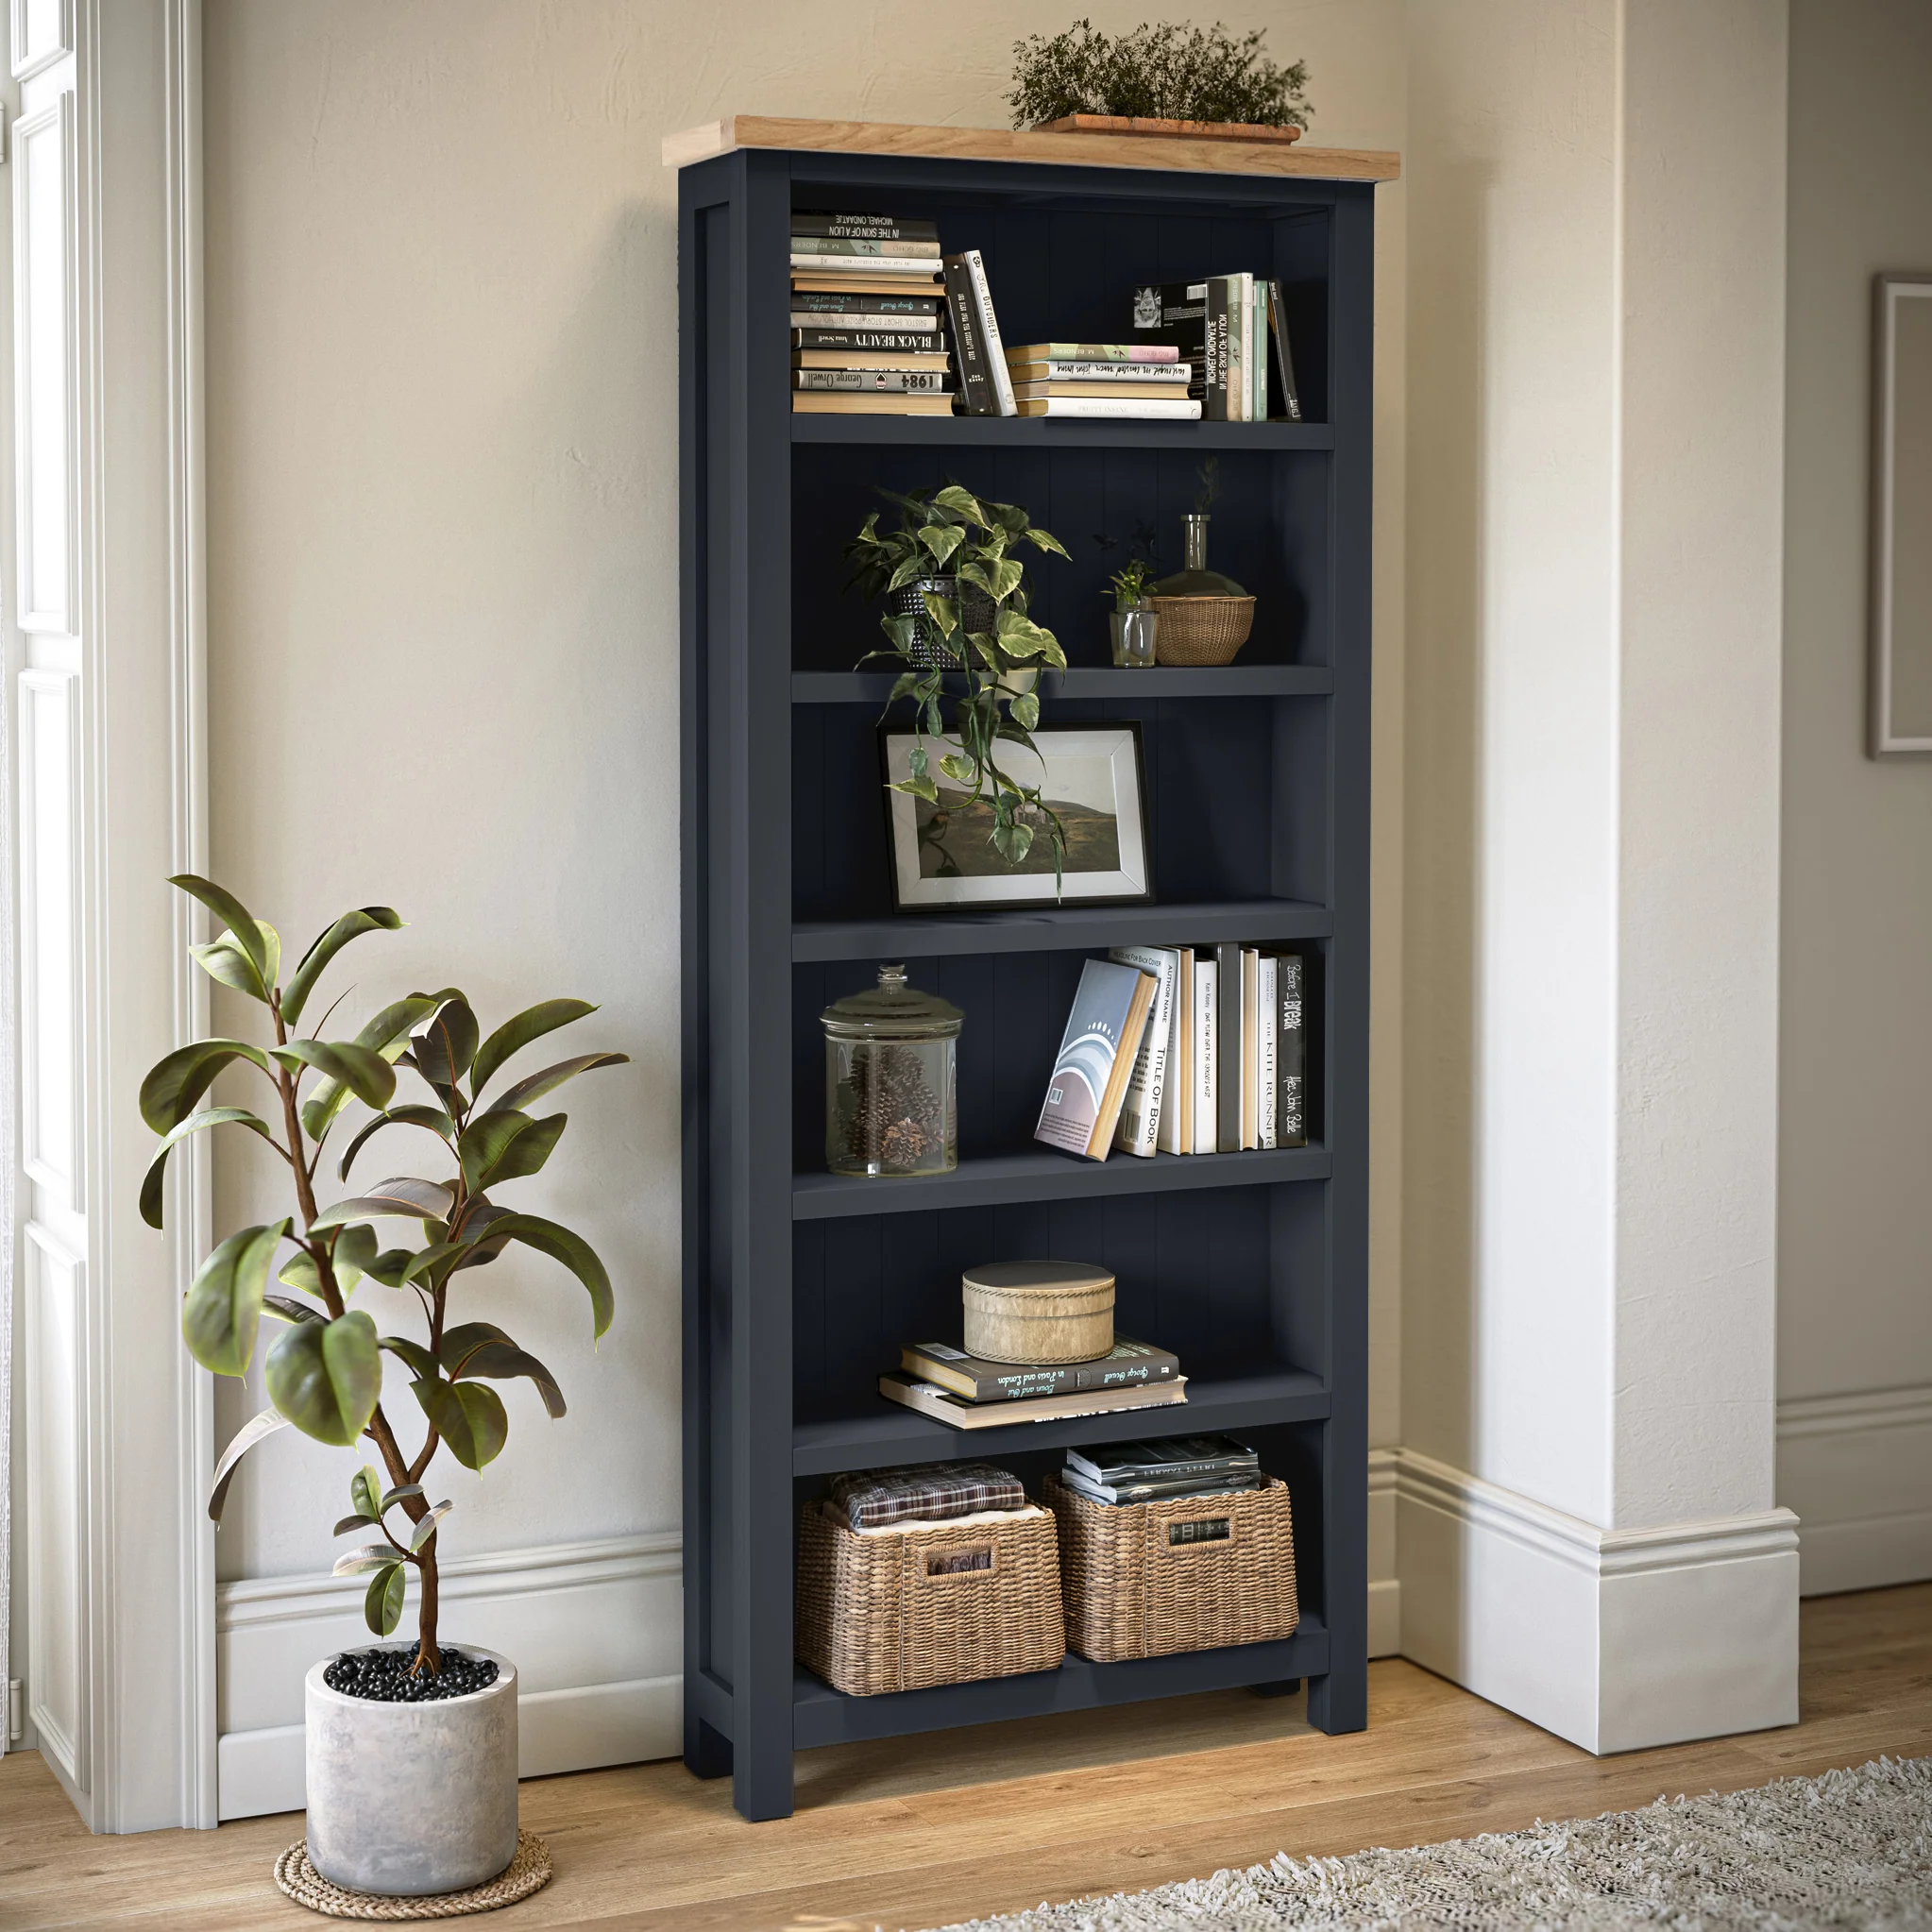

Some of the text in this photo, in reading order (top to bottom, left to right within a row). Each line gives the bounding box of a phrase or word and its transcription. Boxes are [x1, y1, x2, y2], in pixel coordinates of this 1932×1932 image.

[836, 214, 893, 226] MICHAEL ONDAATJE
[829, 226, 900, 239] IN THE SKIN OF A LION
[983, 296, 998, 338] OUTSIDERS
[855, 334, 932, 347] BLACK BEAUTY
[807, 372, 862, 388] George Orwell
[901, 375, 934, 389] 1984
[1286, 964, 1302, 991] Before
[1286, 991, 1300, 1000] I
[1161, 999, 1170, 1023] NAME
[1146, 1047, 1166, 1144] TITLE OF BOOK
[1286, 1092, 1302, 1113] John
[1286, 1113, 1302, 1134] Belle
[997, 1374, 1023, 1387] London
[1023, 1373, 1036, 1384] and
[1037, 1370, 1057, 1382] Paris
[1103, 1366, 1148, 1383] George Orwell
[1022, 1386, 1035, 1397] and
